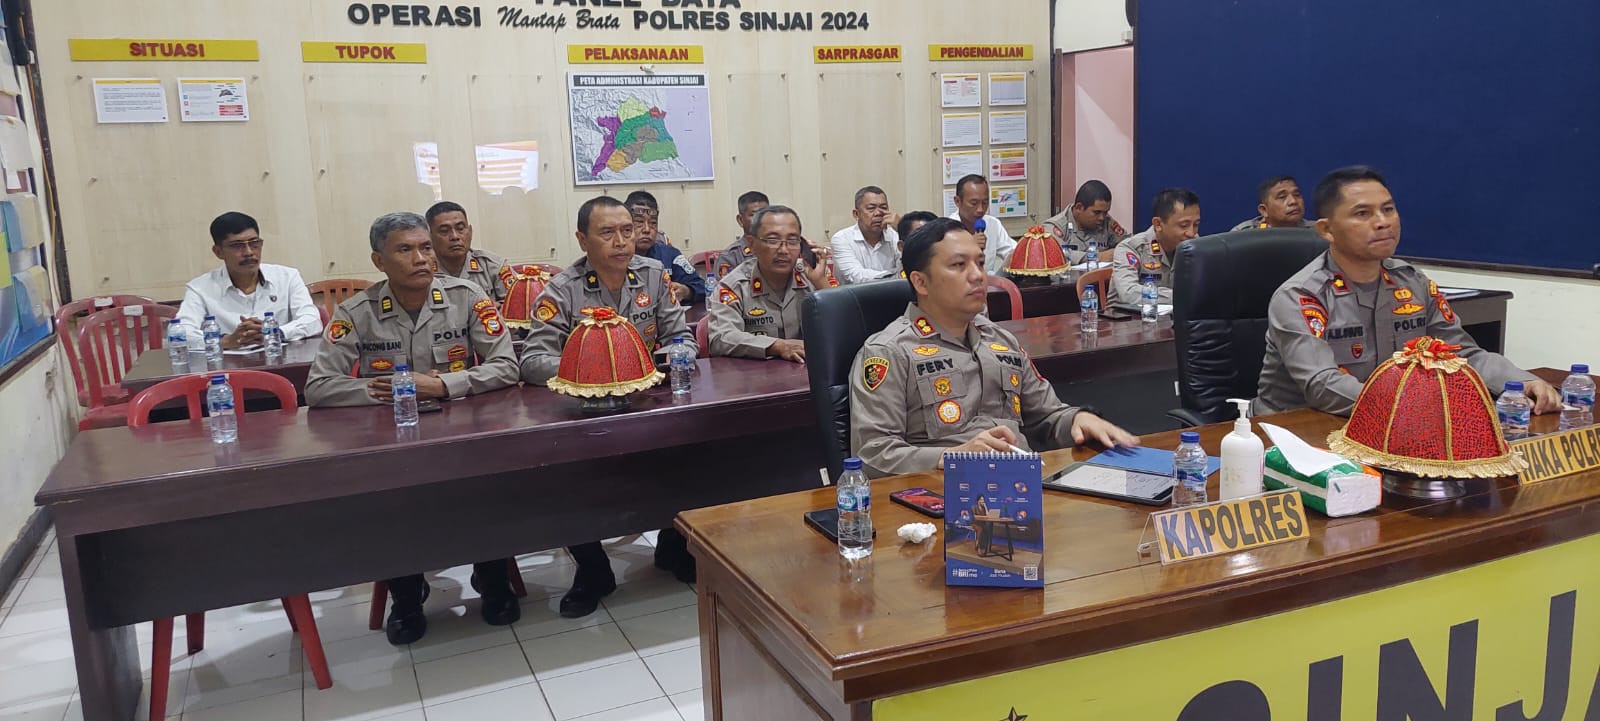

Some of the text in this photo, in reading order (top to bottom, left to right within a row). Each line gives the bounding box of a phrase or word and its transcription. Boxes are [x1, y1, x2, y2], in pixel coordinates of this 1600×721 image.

[348, 4, 869, 32] OPERASI Mantap Brata POLRES SINJAI 2024
[129, 42, 205, 57] SITUASI
[335, 45, 396, 60] TUPOK
[584, 48, 689, 60] PELAKSANAAN
[818, 47, 899, 60] SARPRASGAR
[940, 47, 1024, 58] PENGENDALIAN
[579, 76, 595, 85] PETA
[916, 358, 954, 376] FERY
[1514, 438, 1566, 481] WAKA
[1160, 493, 1303, 560] KAPOLRES
